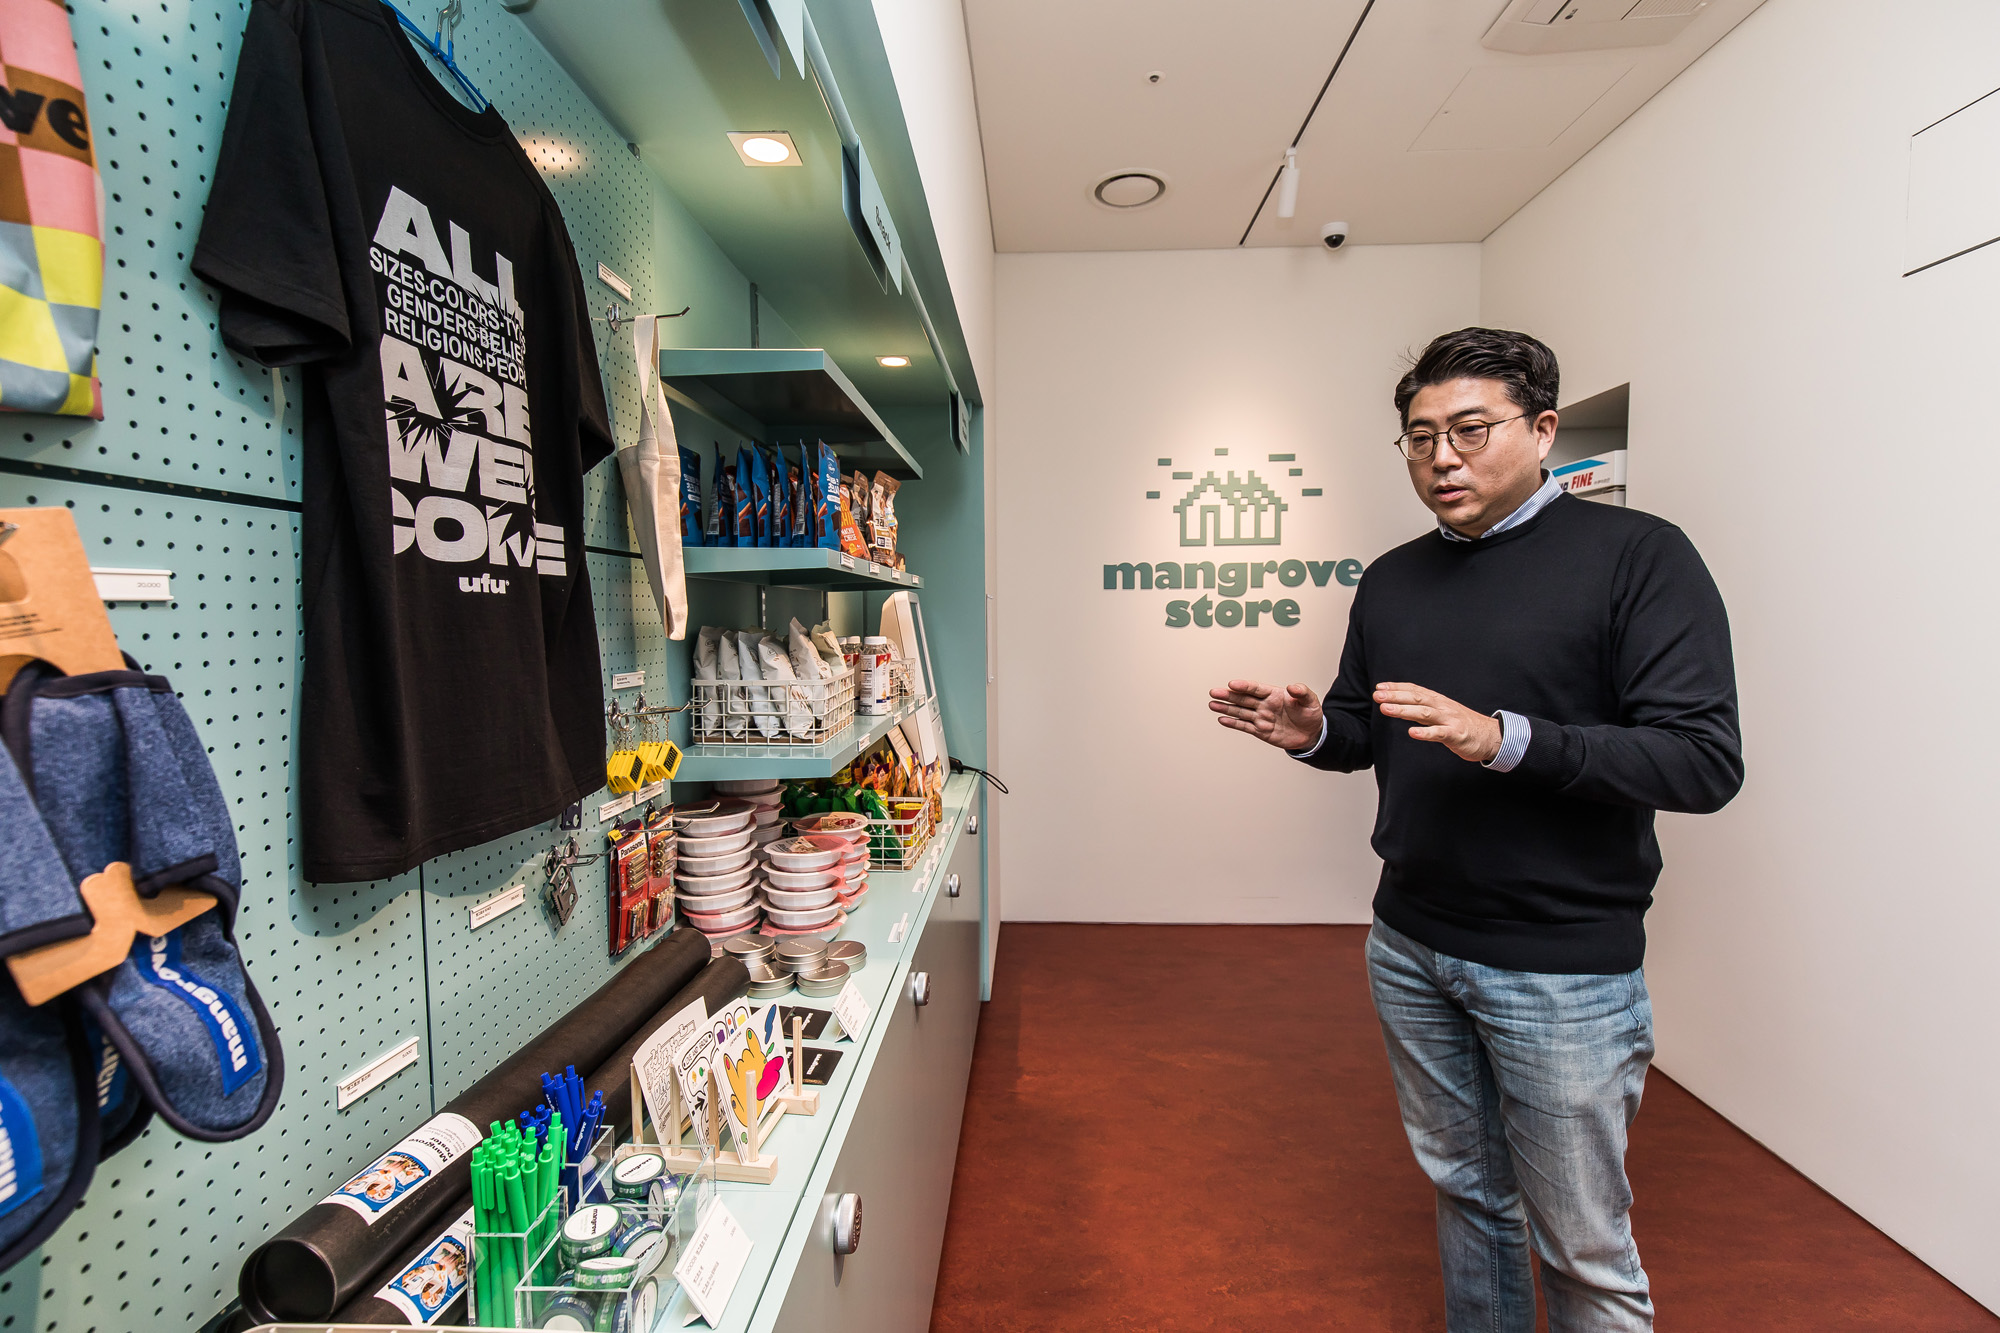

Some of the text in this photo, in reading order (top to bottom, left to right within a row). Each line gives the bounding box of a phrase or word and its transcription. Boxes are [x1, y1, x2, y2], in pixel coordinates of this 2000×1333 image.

[380, 334, 532, 450] ARE
[1571, 472, 1594, 490] FINE
[459, 573, 510, 594] ufu
[1103, 558, 1364, 598] mangrove
[1165, 593, 1301, 628] store
[620, 839, 645, 857] Panasonic
[408, 1138, 448, 1163] Mangrove
[429, 1137, 454, 1158] Poster
[621, 1157, 653, 1178] mangrove
